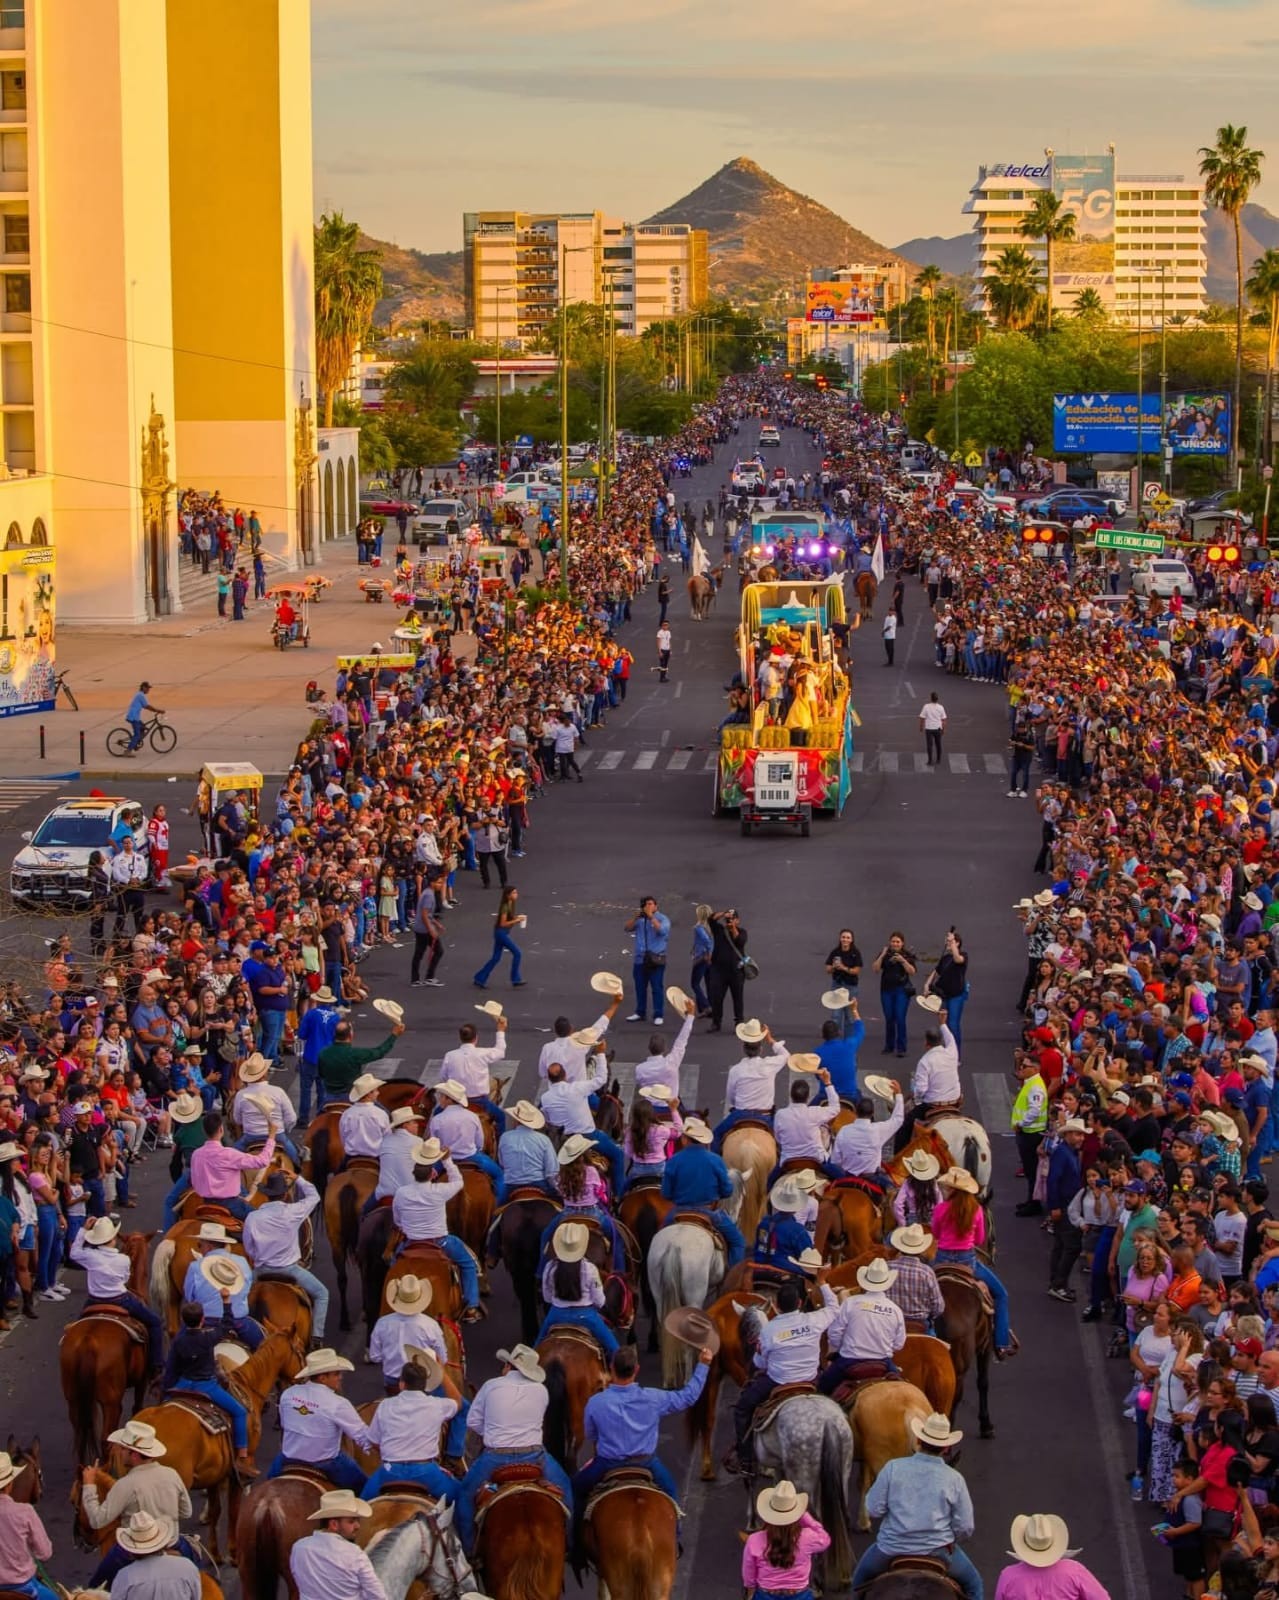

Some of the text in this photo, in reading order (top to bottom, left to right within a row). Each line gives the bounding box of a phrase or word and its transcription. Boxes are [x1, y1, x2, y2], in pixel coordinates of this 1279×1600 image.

[1004, 164, 1049, 177] telcel
[1055, 188, 1112, 224] 5G
[1073, 275, 1104, 285] telcel
[1066, 404, 1138, 414] Educación de
[1066, 414, 1125, 423] reconocida
[1182, 440, 1221, 448] UNISON
